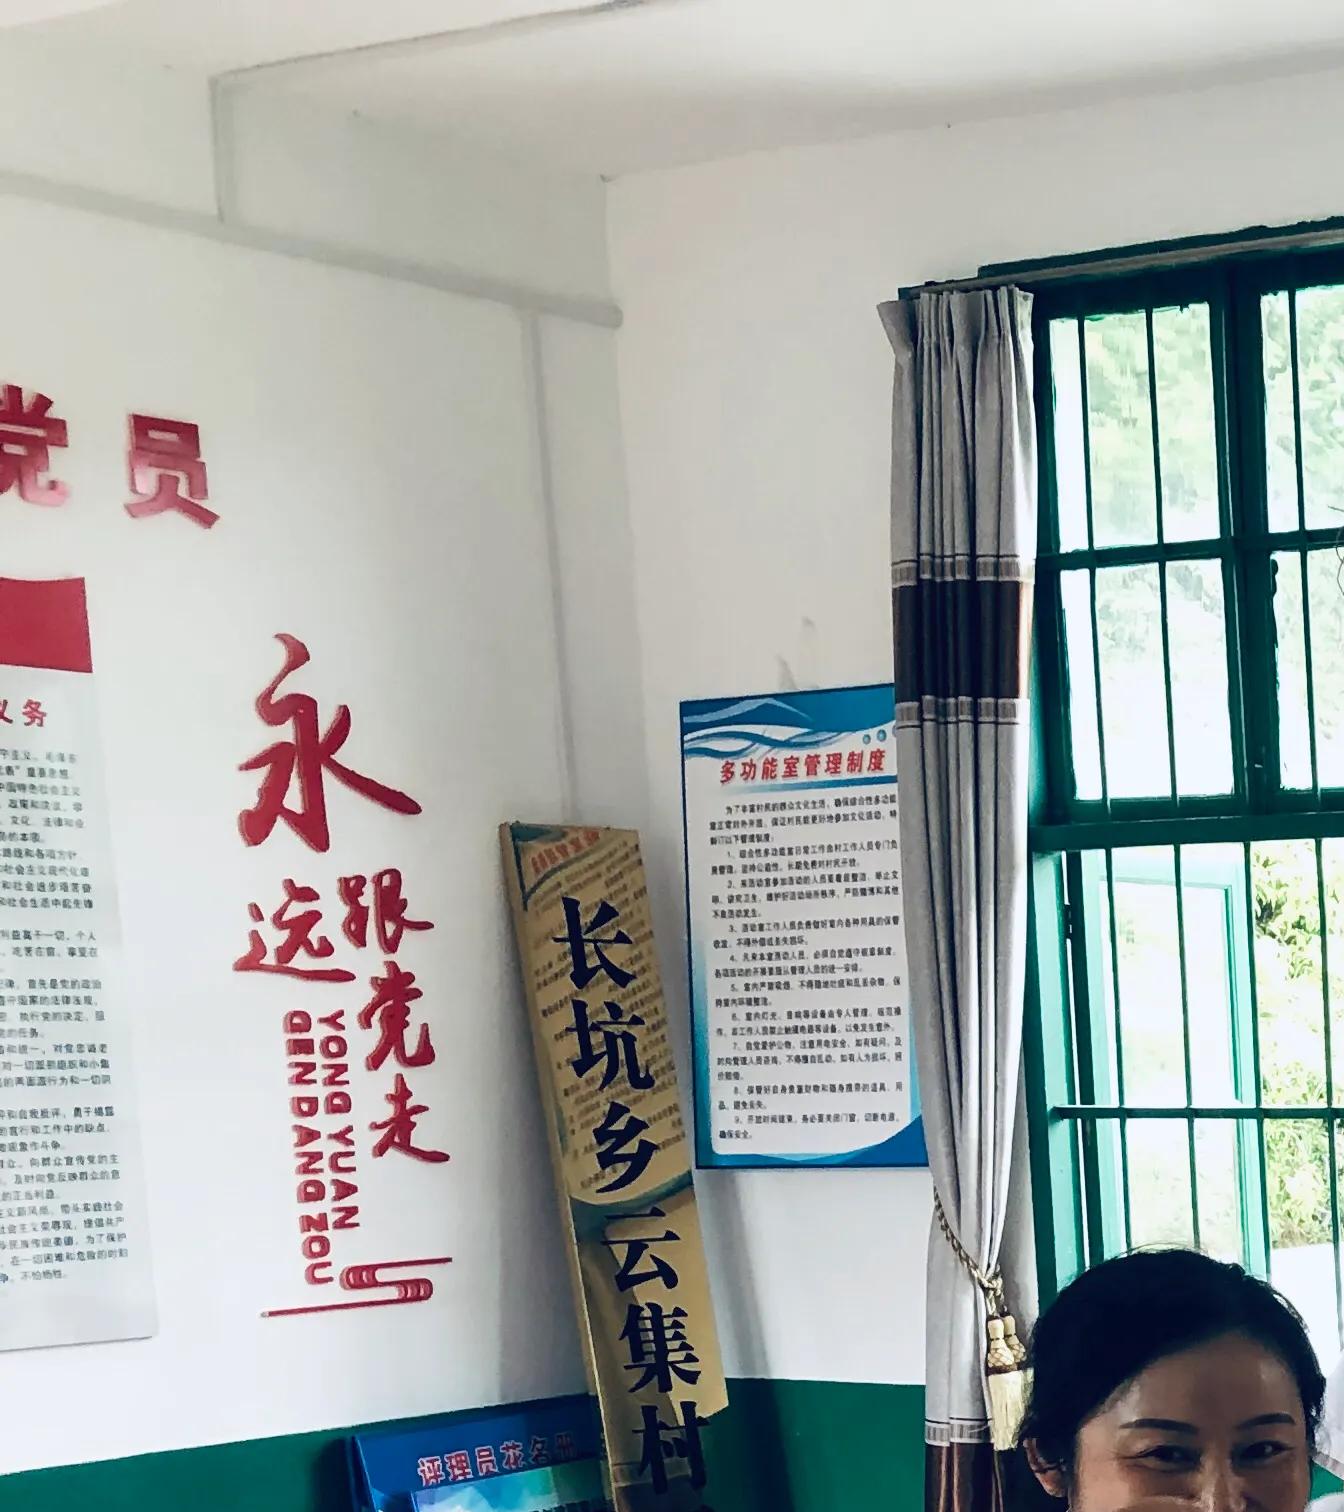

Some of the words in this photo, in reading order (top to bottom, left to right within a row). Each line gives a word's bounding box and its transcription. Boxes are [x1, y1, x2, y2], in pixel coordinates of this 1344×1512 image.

[0, 383, 220, 529] 党员
[719, 748, 887, 786] 多功能室管理制度
[317, 1008, 352, 1115] YONG
[290, 1096, 327, 1204] DANG
[327, 1124, 361, 1230] YUAN
[299, 1211, 334, 1285] ZOU
